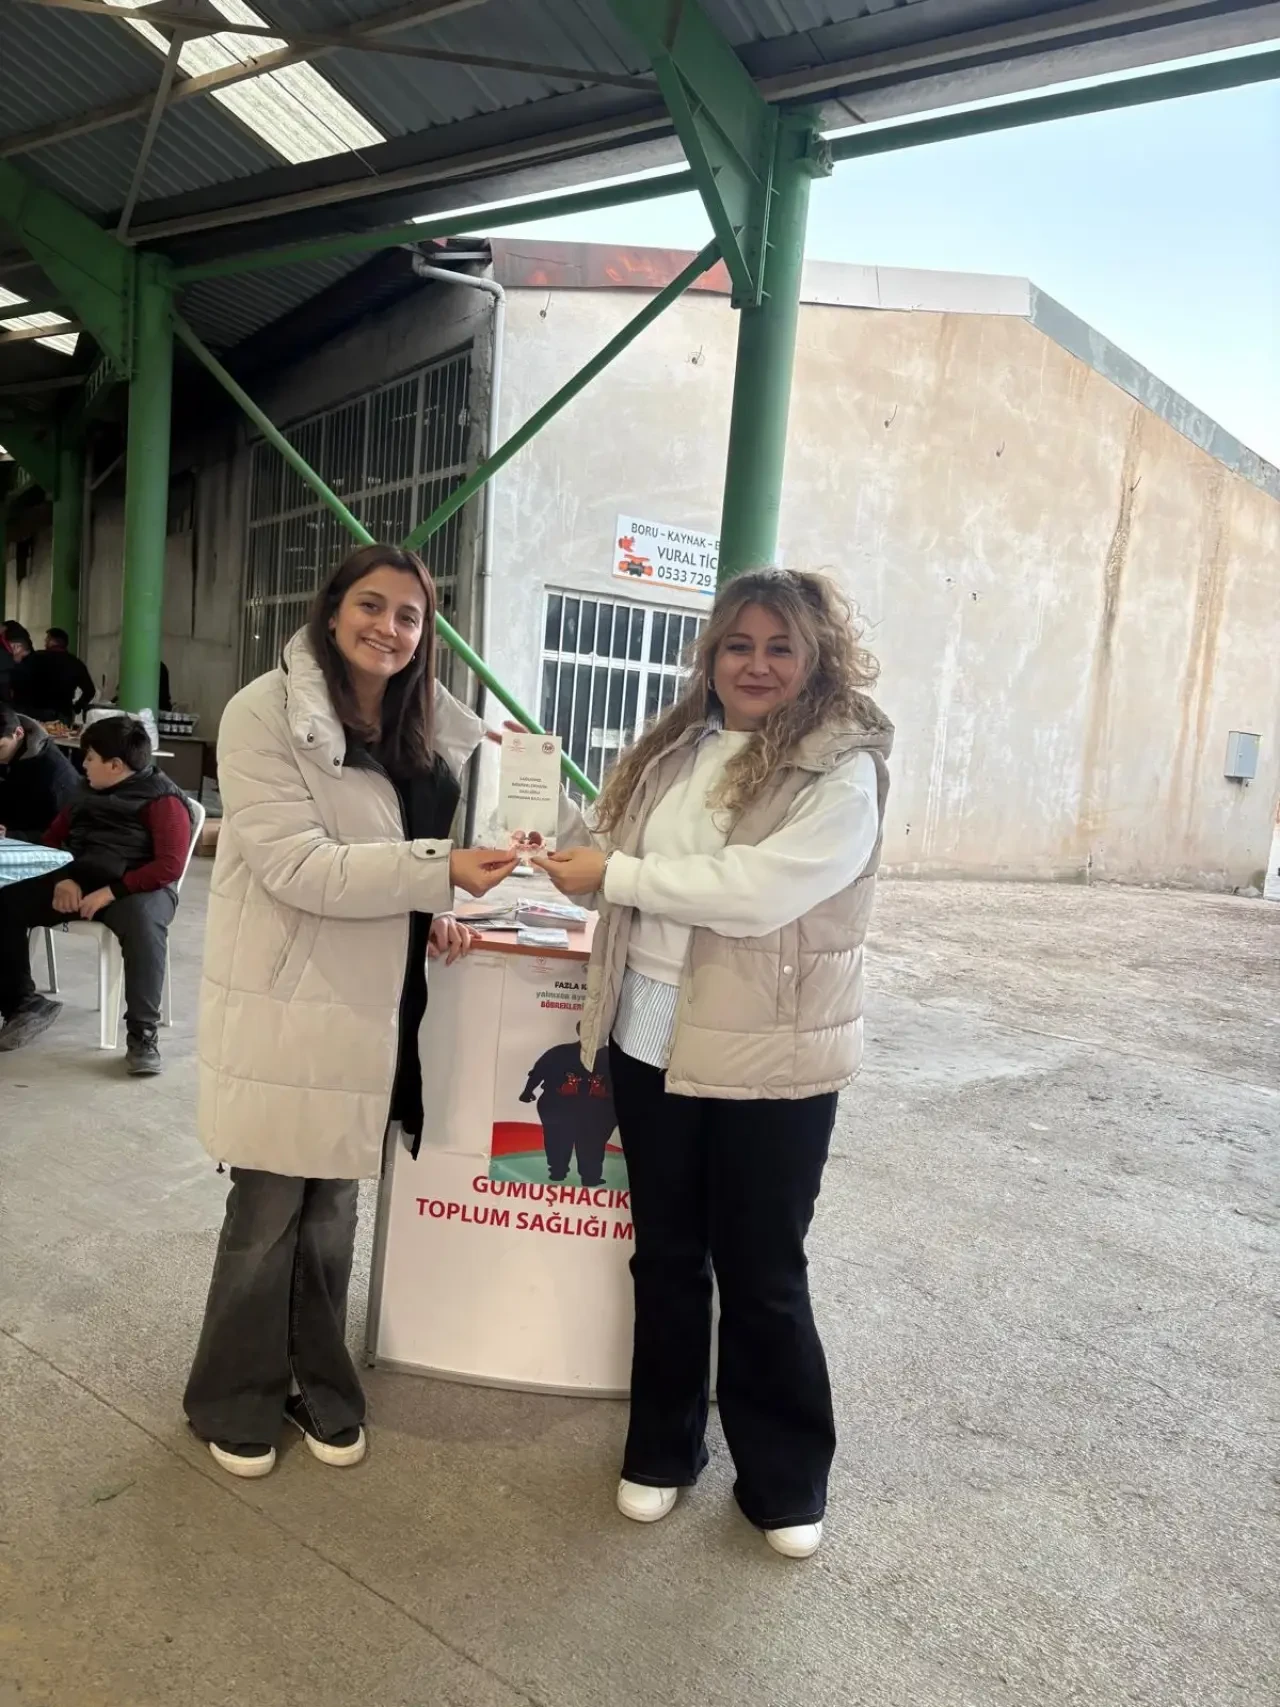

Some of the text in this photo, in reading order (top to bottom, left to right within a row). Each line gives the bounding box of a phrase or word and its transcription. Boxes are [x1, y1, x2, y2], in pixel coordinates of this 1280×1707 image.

[631, 523, 658, 538] BORU
[668, 530, 706, 548] KAYNAK
[657, 546, 696, 566] VURAL
[657, 566, 687, 583] 0533
[690, 572, 711, 587] 729
[554, 981, 579, 990] FAZLA
[416, 1198, 633, 1240] TOPLUM SAĞLIĞI M
